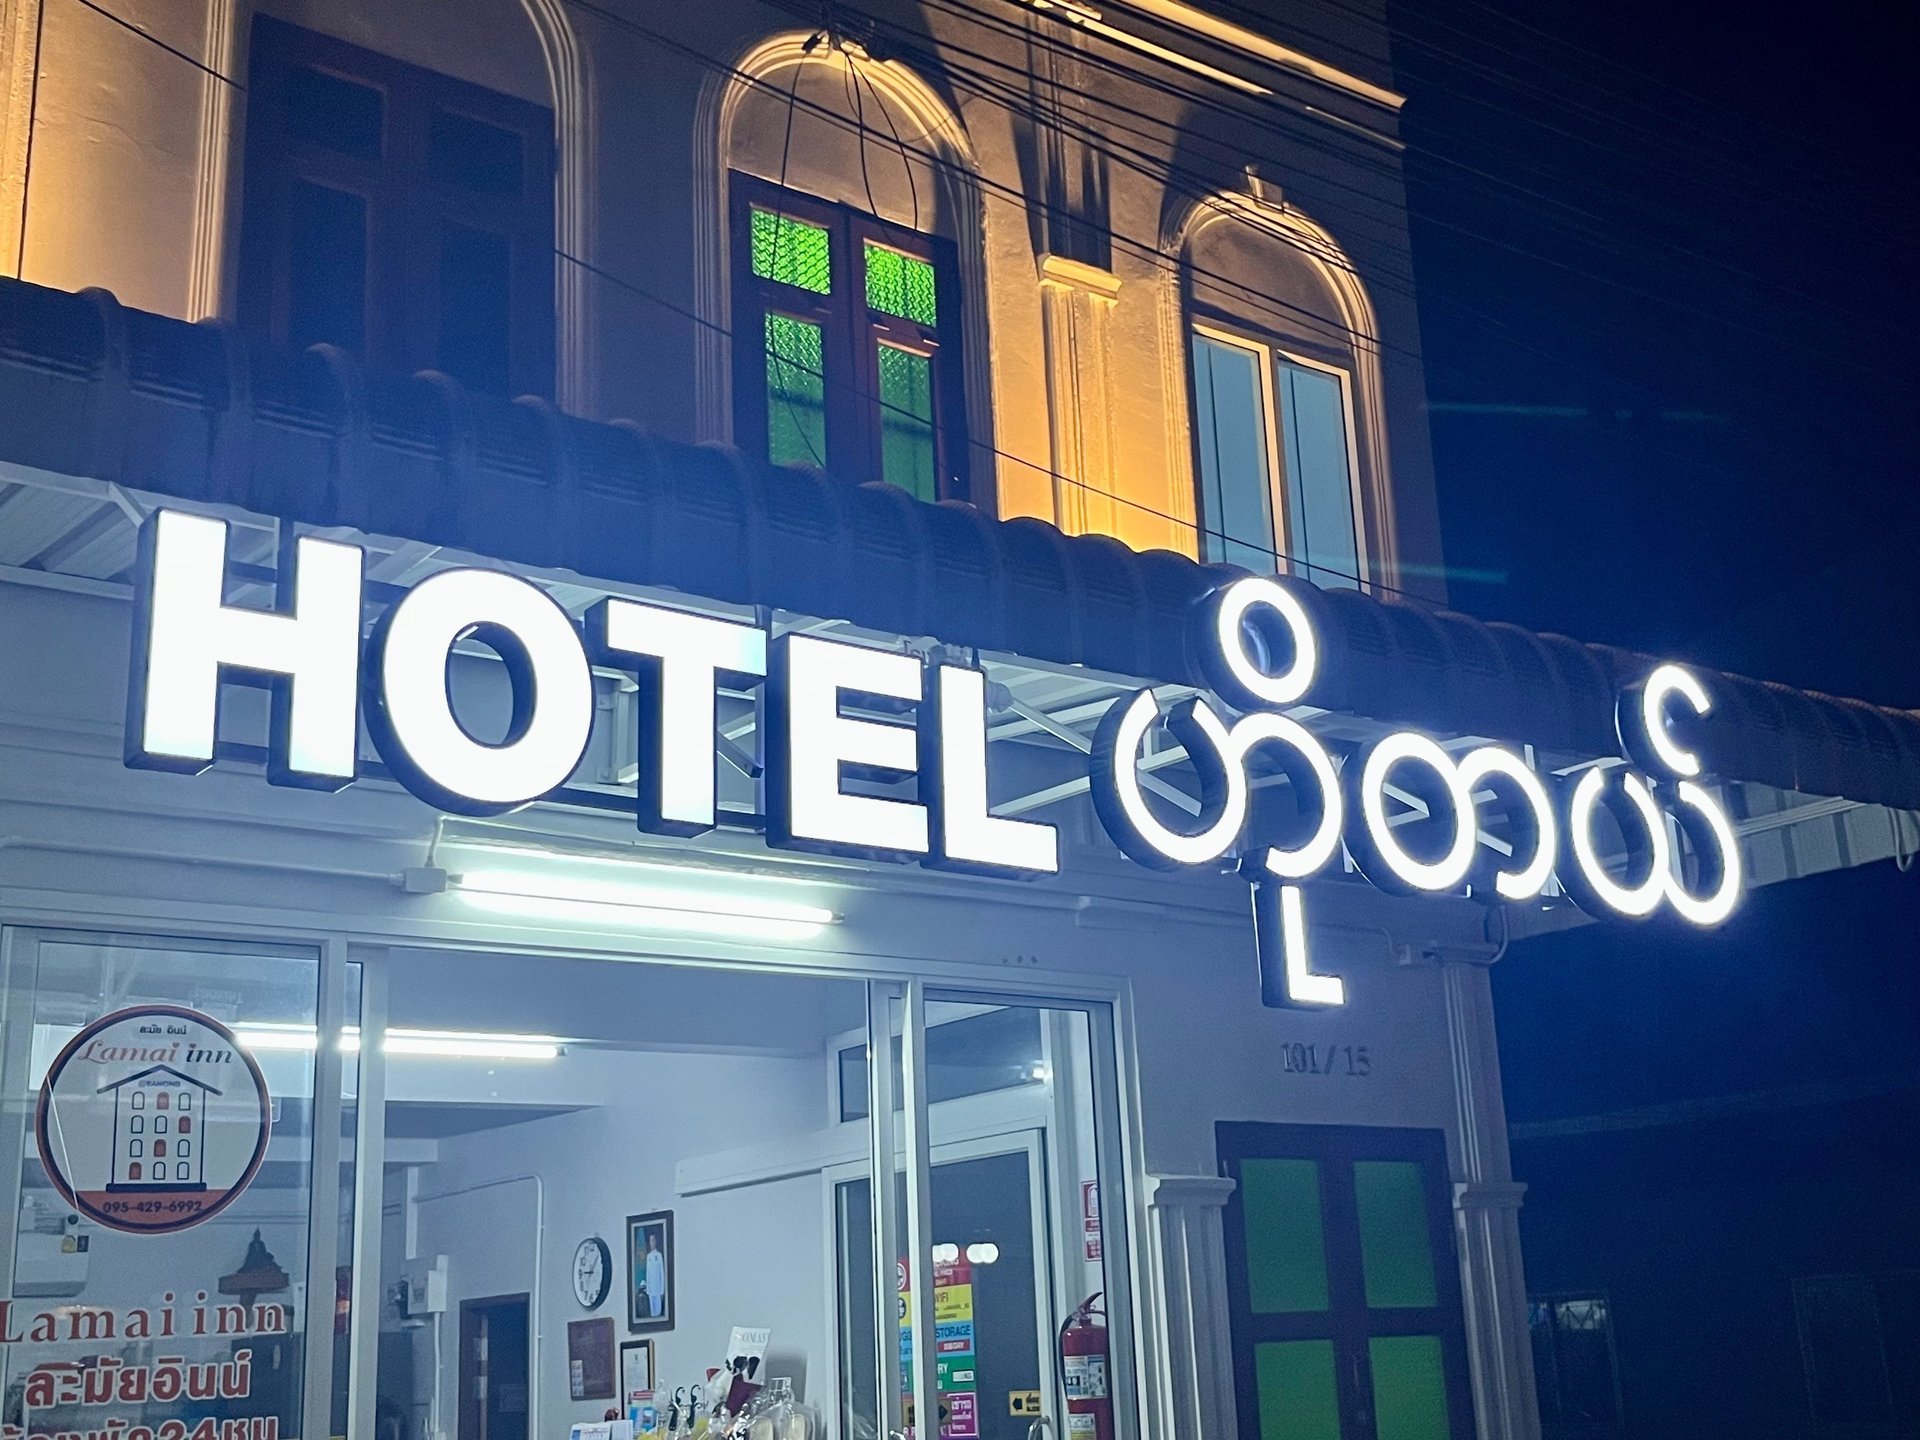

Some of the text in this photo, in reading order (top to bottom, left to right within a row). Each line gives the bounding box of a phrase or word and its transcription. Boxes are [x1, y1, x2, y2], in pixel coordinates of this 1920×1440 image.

[136, 508, 1058, 874] HOTEL
[1114, 576, 1742, 1004] ဟိုတယ်
[78, 1040, 232, 1064] Lamai inn
[1281, 1042, 1370, 1076] 101/15
[103, 1201, 202, 1213] 095-429-6992
[0, 1290, 286, 1343] Lamai inn
[936, 1325, 971, 1338] STORAGE
[25, 1350, 252, 1407] ละมัยอินน์
